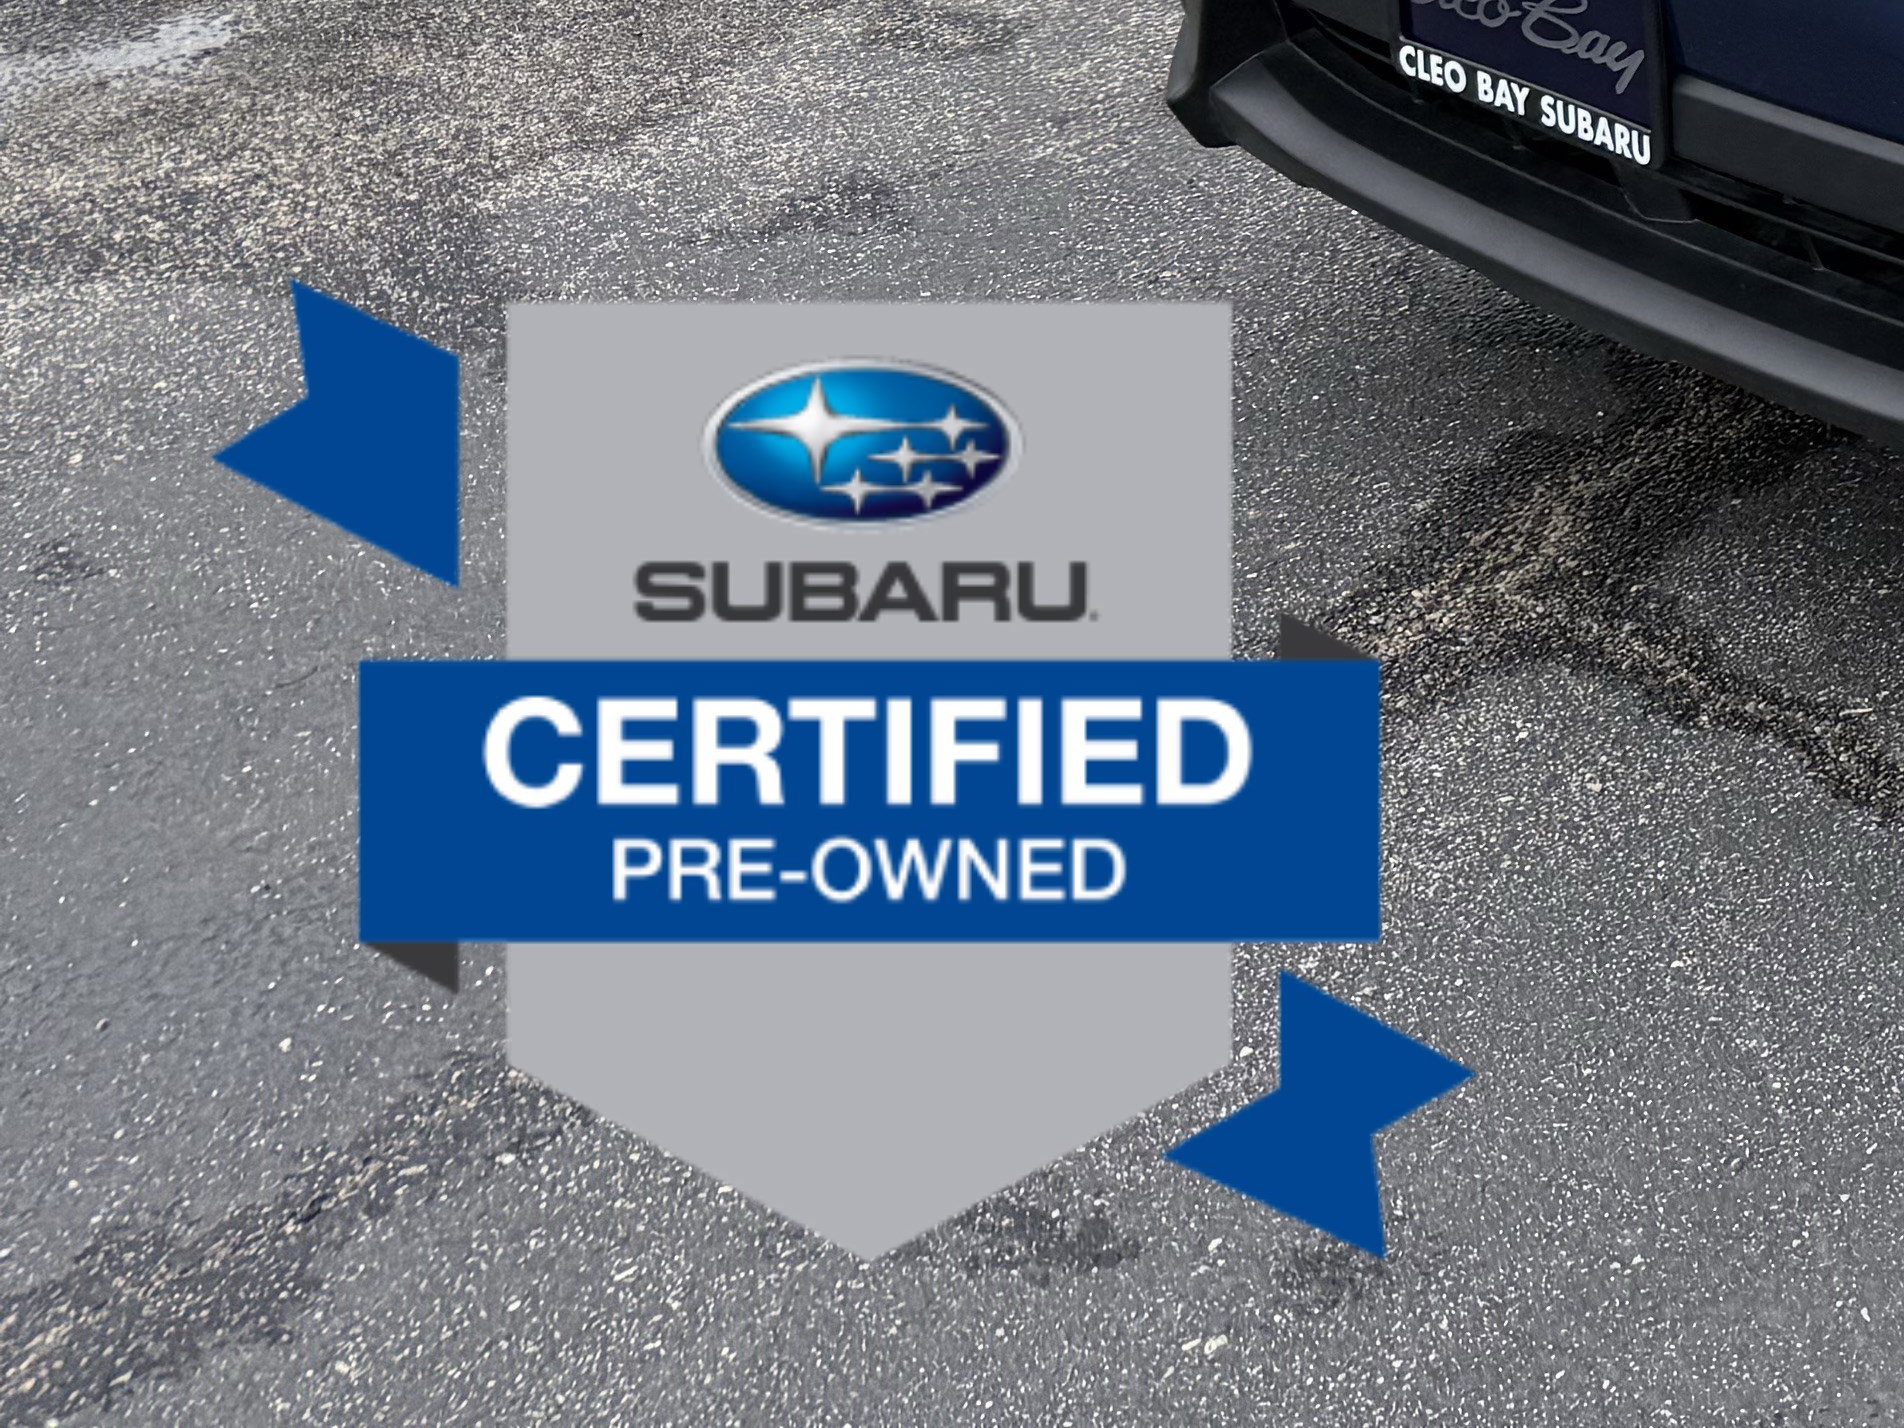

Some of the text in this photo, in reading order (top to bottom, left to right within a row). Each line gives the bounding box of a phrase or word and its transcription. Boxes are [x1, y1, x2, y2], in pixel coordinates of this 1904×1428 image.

[1399, 45, 1651, 165] CLEO BAY SUBARU
